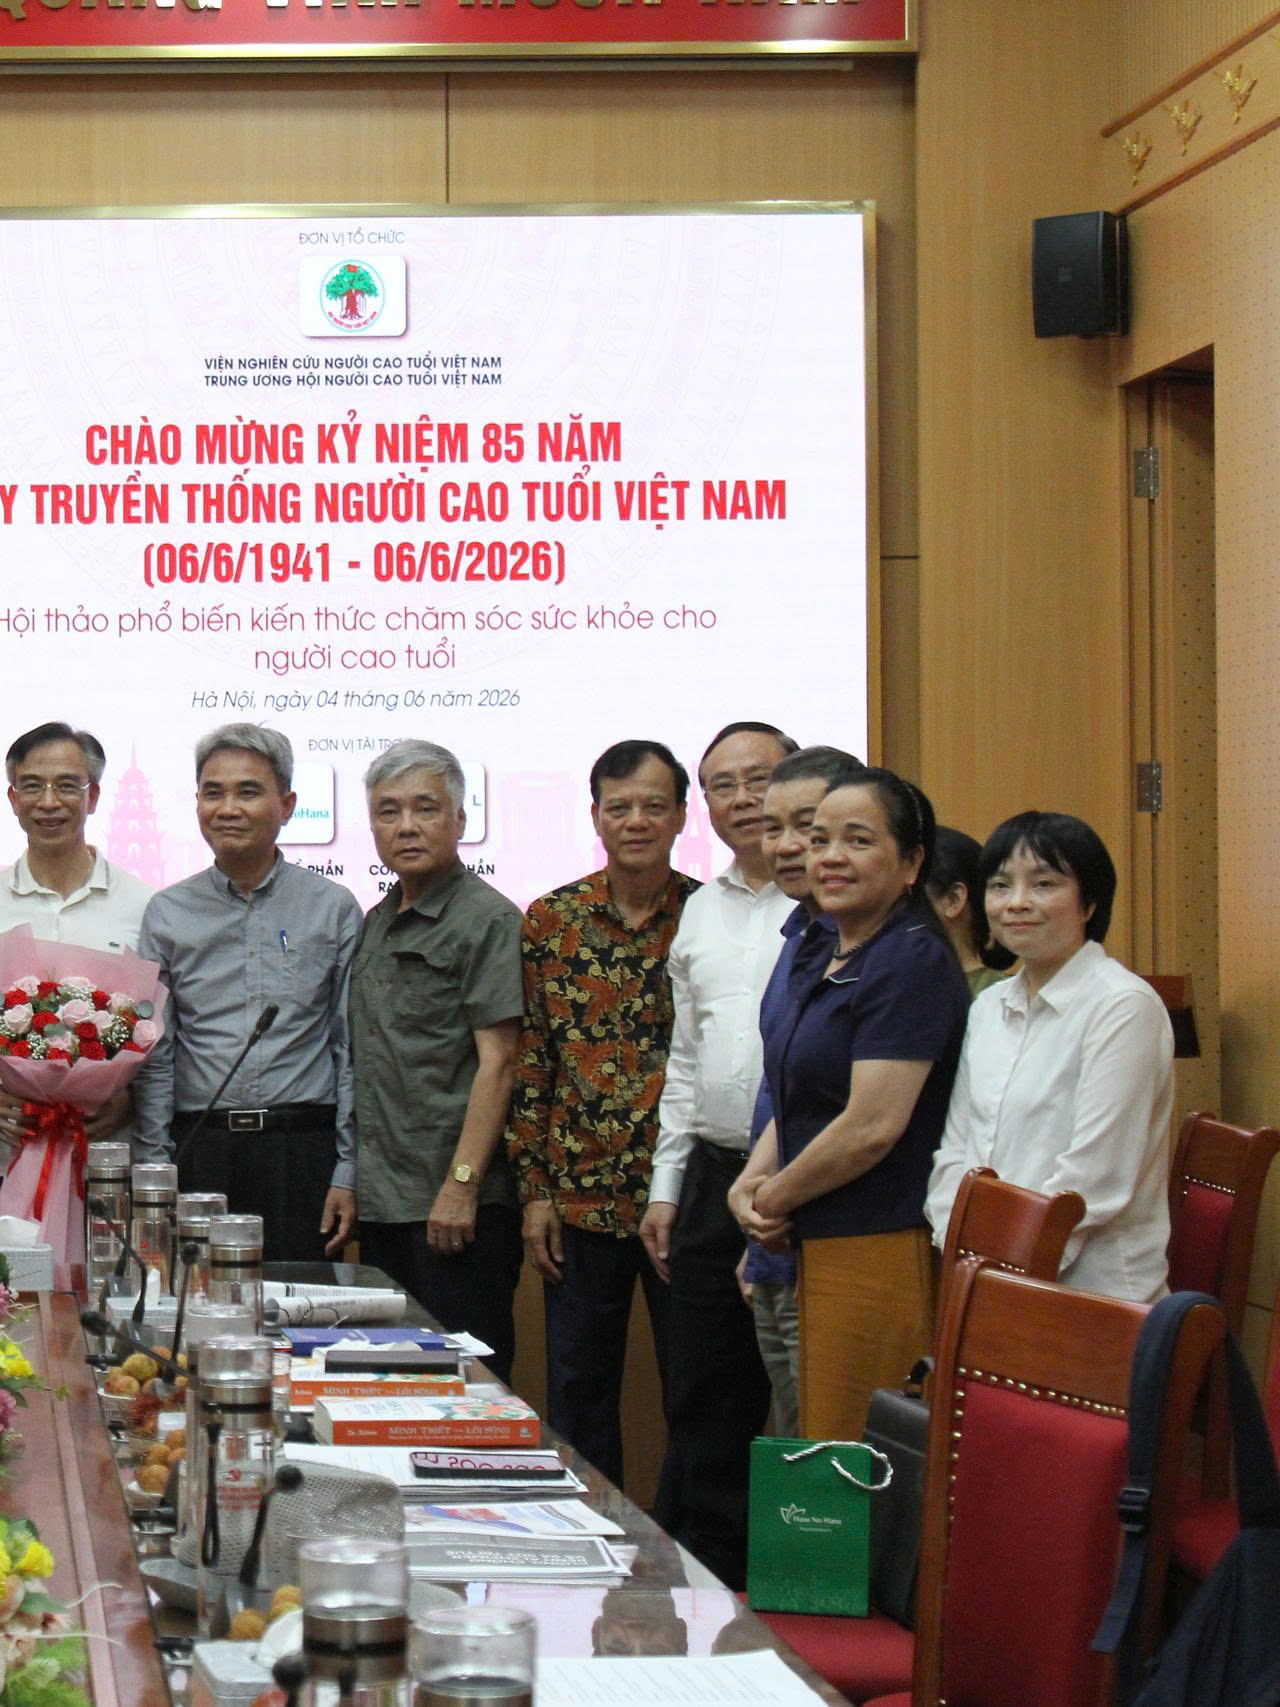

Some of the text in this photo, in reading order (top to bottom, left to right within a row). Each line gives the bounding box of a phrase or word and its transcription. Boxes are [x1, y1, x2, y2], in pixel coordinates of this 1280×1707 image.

[299, 227, 405, 246] ĐƠN VỊ TỔ CHỨC
[205, 350, 502, 373] VIỆN NGHIÊN CỨU NGƯỜI CAO TUỔI VIỆT NAM
[205, 367, 502, 389] TRUNG ƯƠNG HỘI NGƯỜI CAO TUỔI VIỆT NAM
[86, 409, 621, 473] CHÀO MỪNG KỶ NIỆM 85 NĂM
[30, 470, 169, 525] TRUYỀN
[182, 468, 301, 524] THỐNG
[315, 472, 426, 523] NGƯỜI
[440, 482, 509, 523] CAO
[522, 464, 601, 522] TUỔI
[614, 472, 690, 530] VIỆT
[703, 480, 787, 520] NAM
[144, 541, 565, 588] (06/6/1941 - 06/6/2026)
[44, 604, 108, 632] thảo
[119, 600, 172, 638] phổ
[183, 603, 240, 632] biến
[252, 602, 304, 631] kiến
[314, 605, 375, 631] thức
[386, 604, 465, 631] chăm
[475, 604, 521, 630] sóc
[531, 604, 576, 630] sức
[588, 602, 653, 629] khỏe
[664, 604, 716, 629] cho
[255, 636, 455, 676] người cao tuổi
[191, 690, 521, 713] Hà Nội, ngày 04 tháng 06 năm 2026
[308, 738, 338, 751] ĐƠN
[341, 738, 353, 752] VỊ
[357, 736, 375, 750] TÀI
